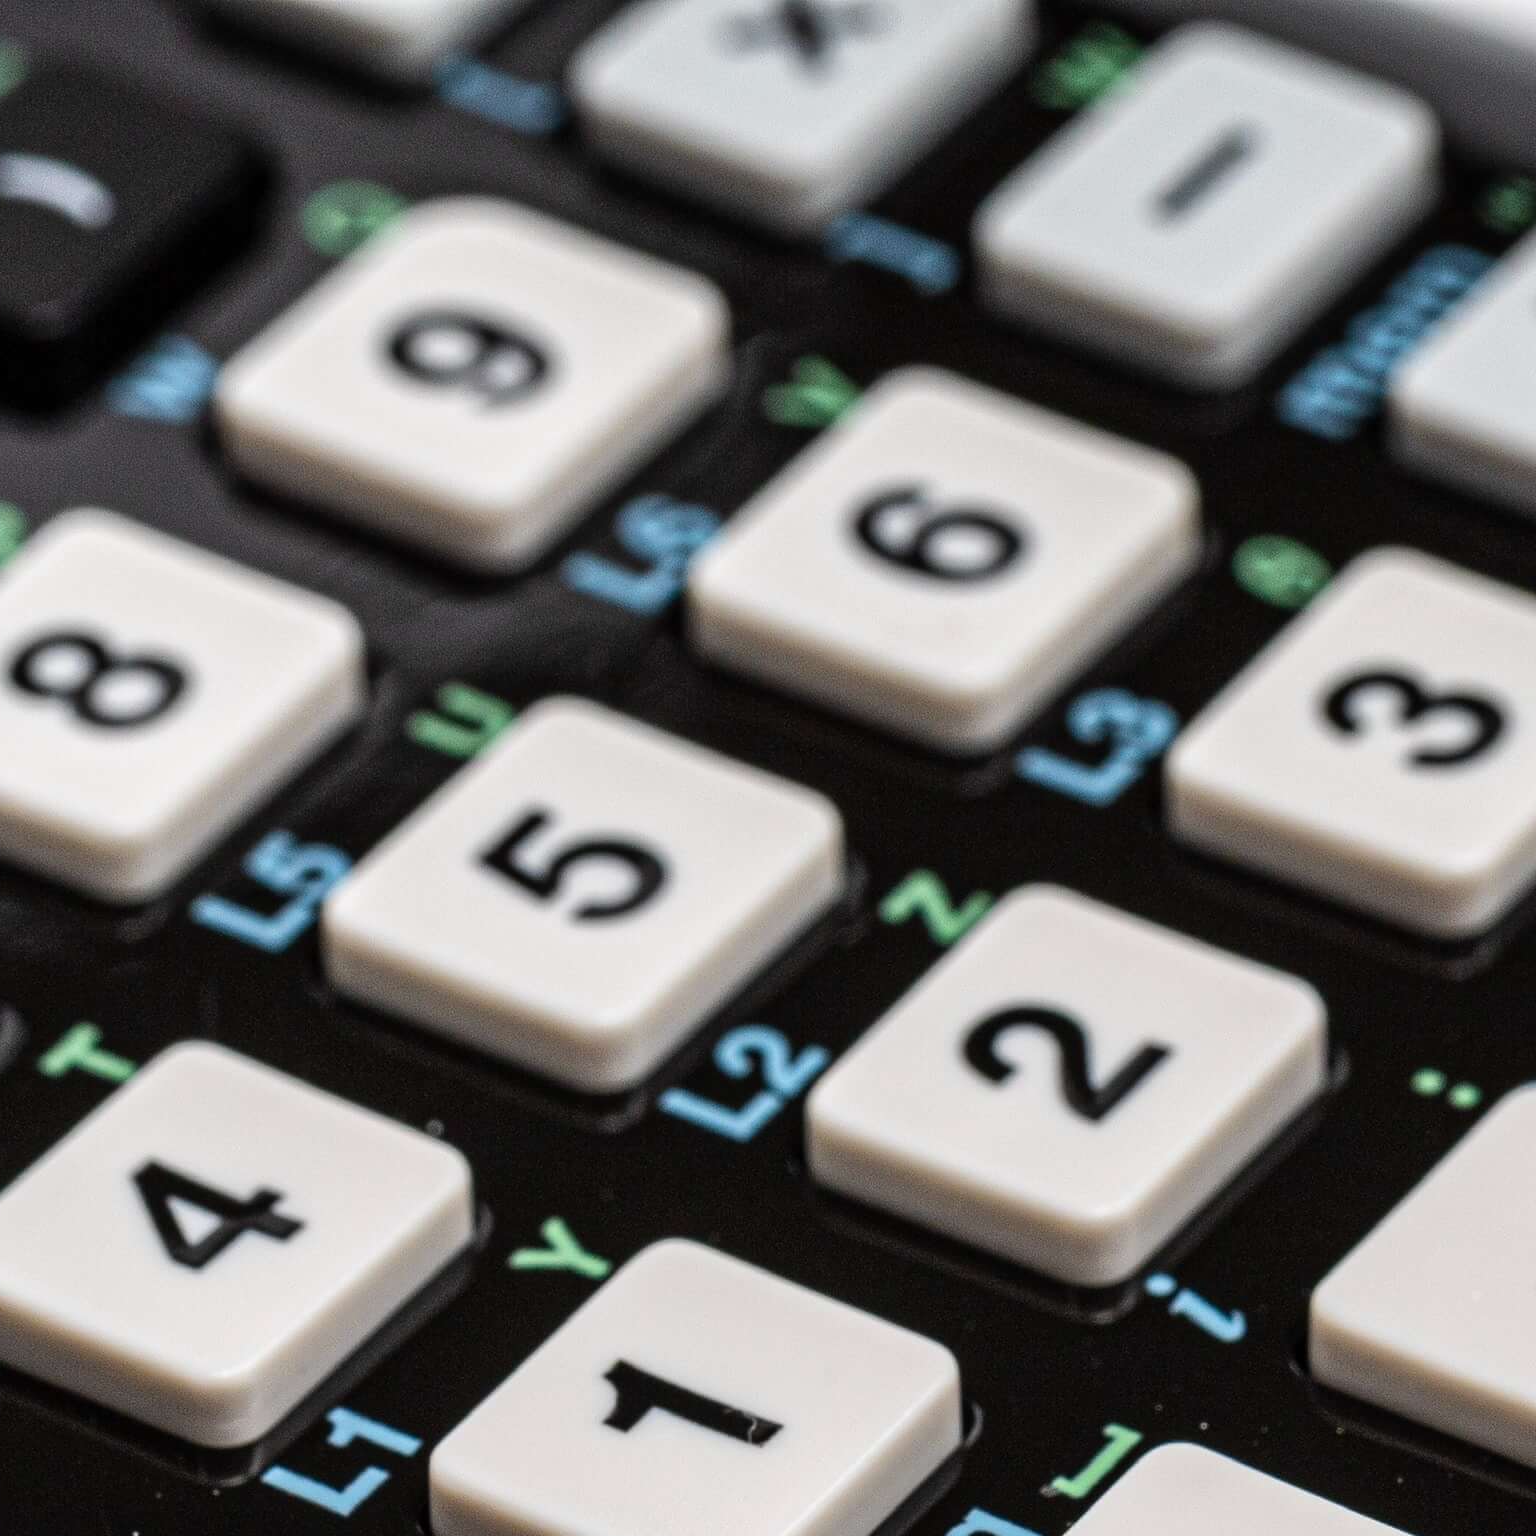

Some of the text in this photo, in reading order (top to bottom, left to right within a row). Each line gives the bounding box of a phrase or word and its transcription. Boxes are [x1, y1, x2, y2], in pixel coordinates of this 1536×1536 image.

[383, 311, 553, 401] 9
[568, 501, 721, 613] L6
[850, 488, 1026, 584] 6
[4, 629, 191, 732] 8
[413, 686, 515, 758] U
[1320, 668, 1508, 770] 3
[1020, 690, 1177, 804] L3
[194, 833, 352, 952] L5
[478, 809, 669, 923] 5
[885, 872, 991, 944] Z
[41, 1024, 137, 1083] T
[661, 1026, 828, 1141] L2
[961, 1004, 1170, 1123] 2
[132, 1161, 303, 1270] 4
[513, 1219, 610, 1279] Y
[604, 1360, 781, 1446] 1
[263, 1406, 422, 1514] L1
